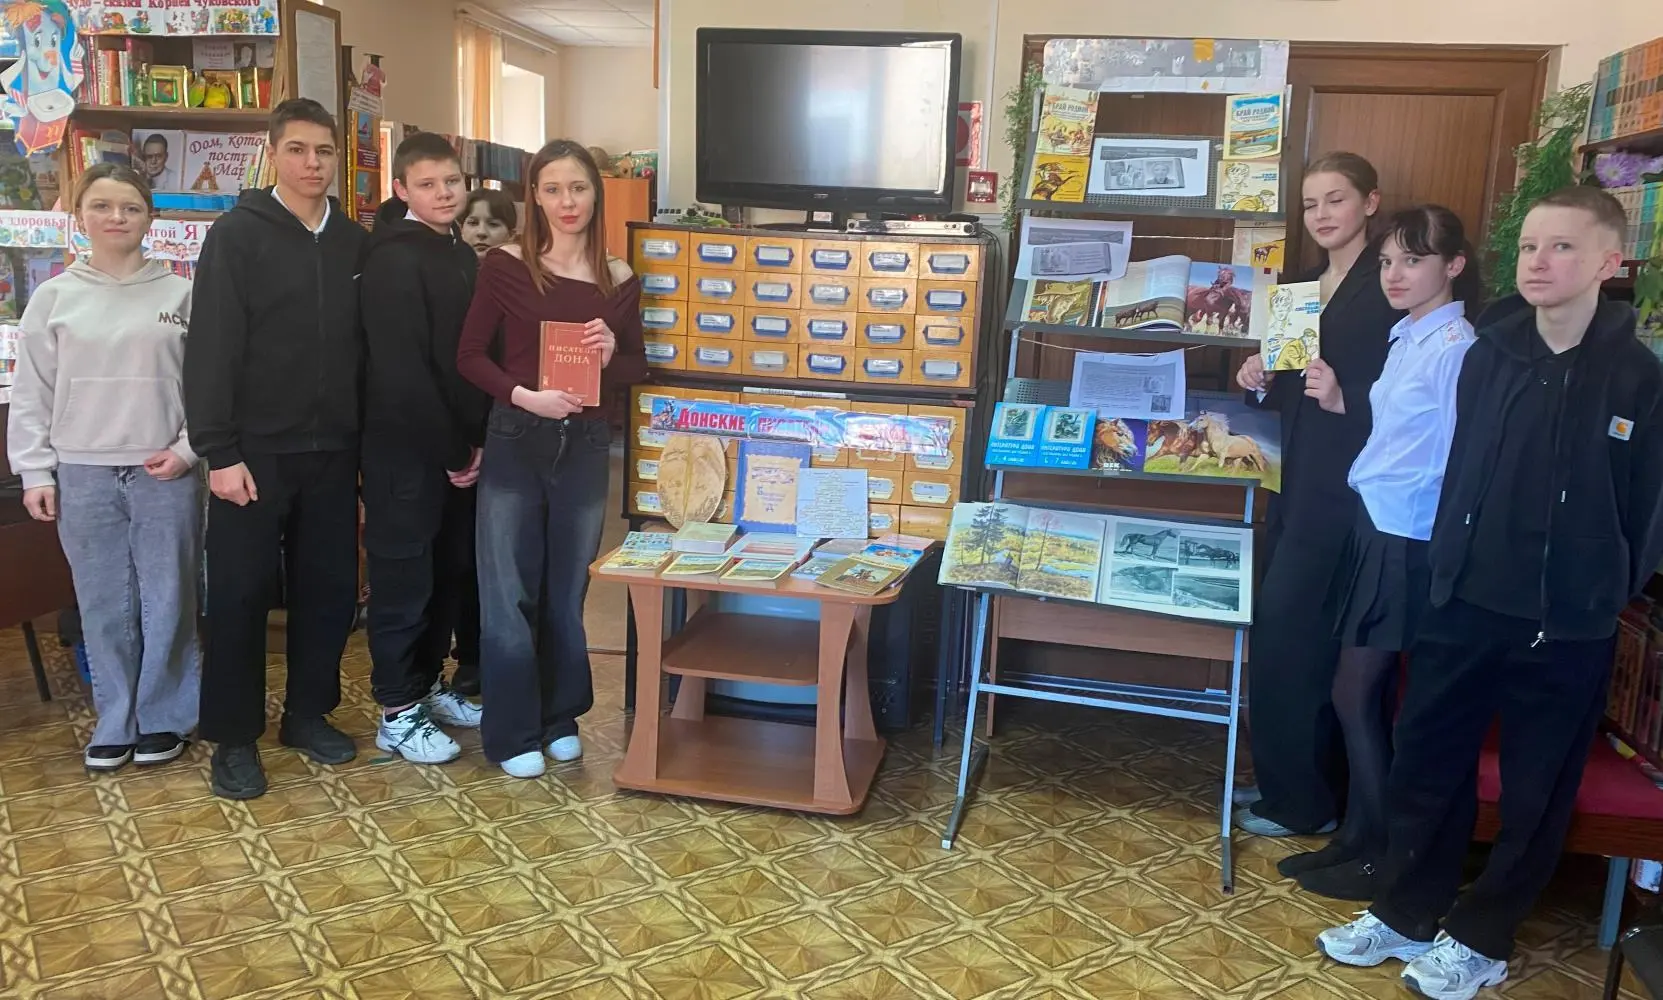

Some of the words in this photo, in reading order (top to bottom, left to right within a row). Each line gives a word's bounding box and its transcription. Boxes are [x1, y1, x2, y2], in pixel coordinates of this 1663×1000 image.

[189, 138, 223, 154] Дом,
[184, 224, 198, 240] Я
[554, 353, 590, 365] ДОНА
